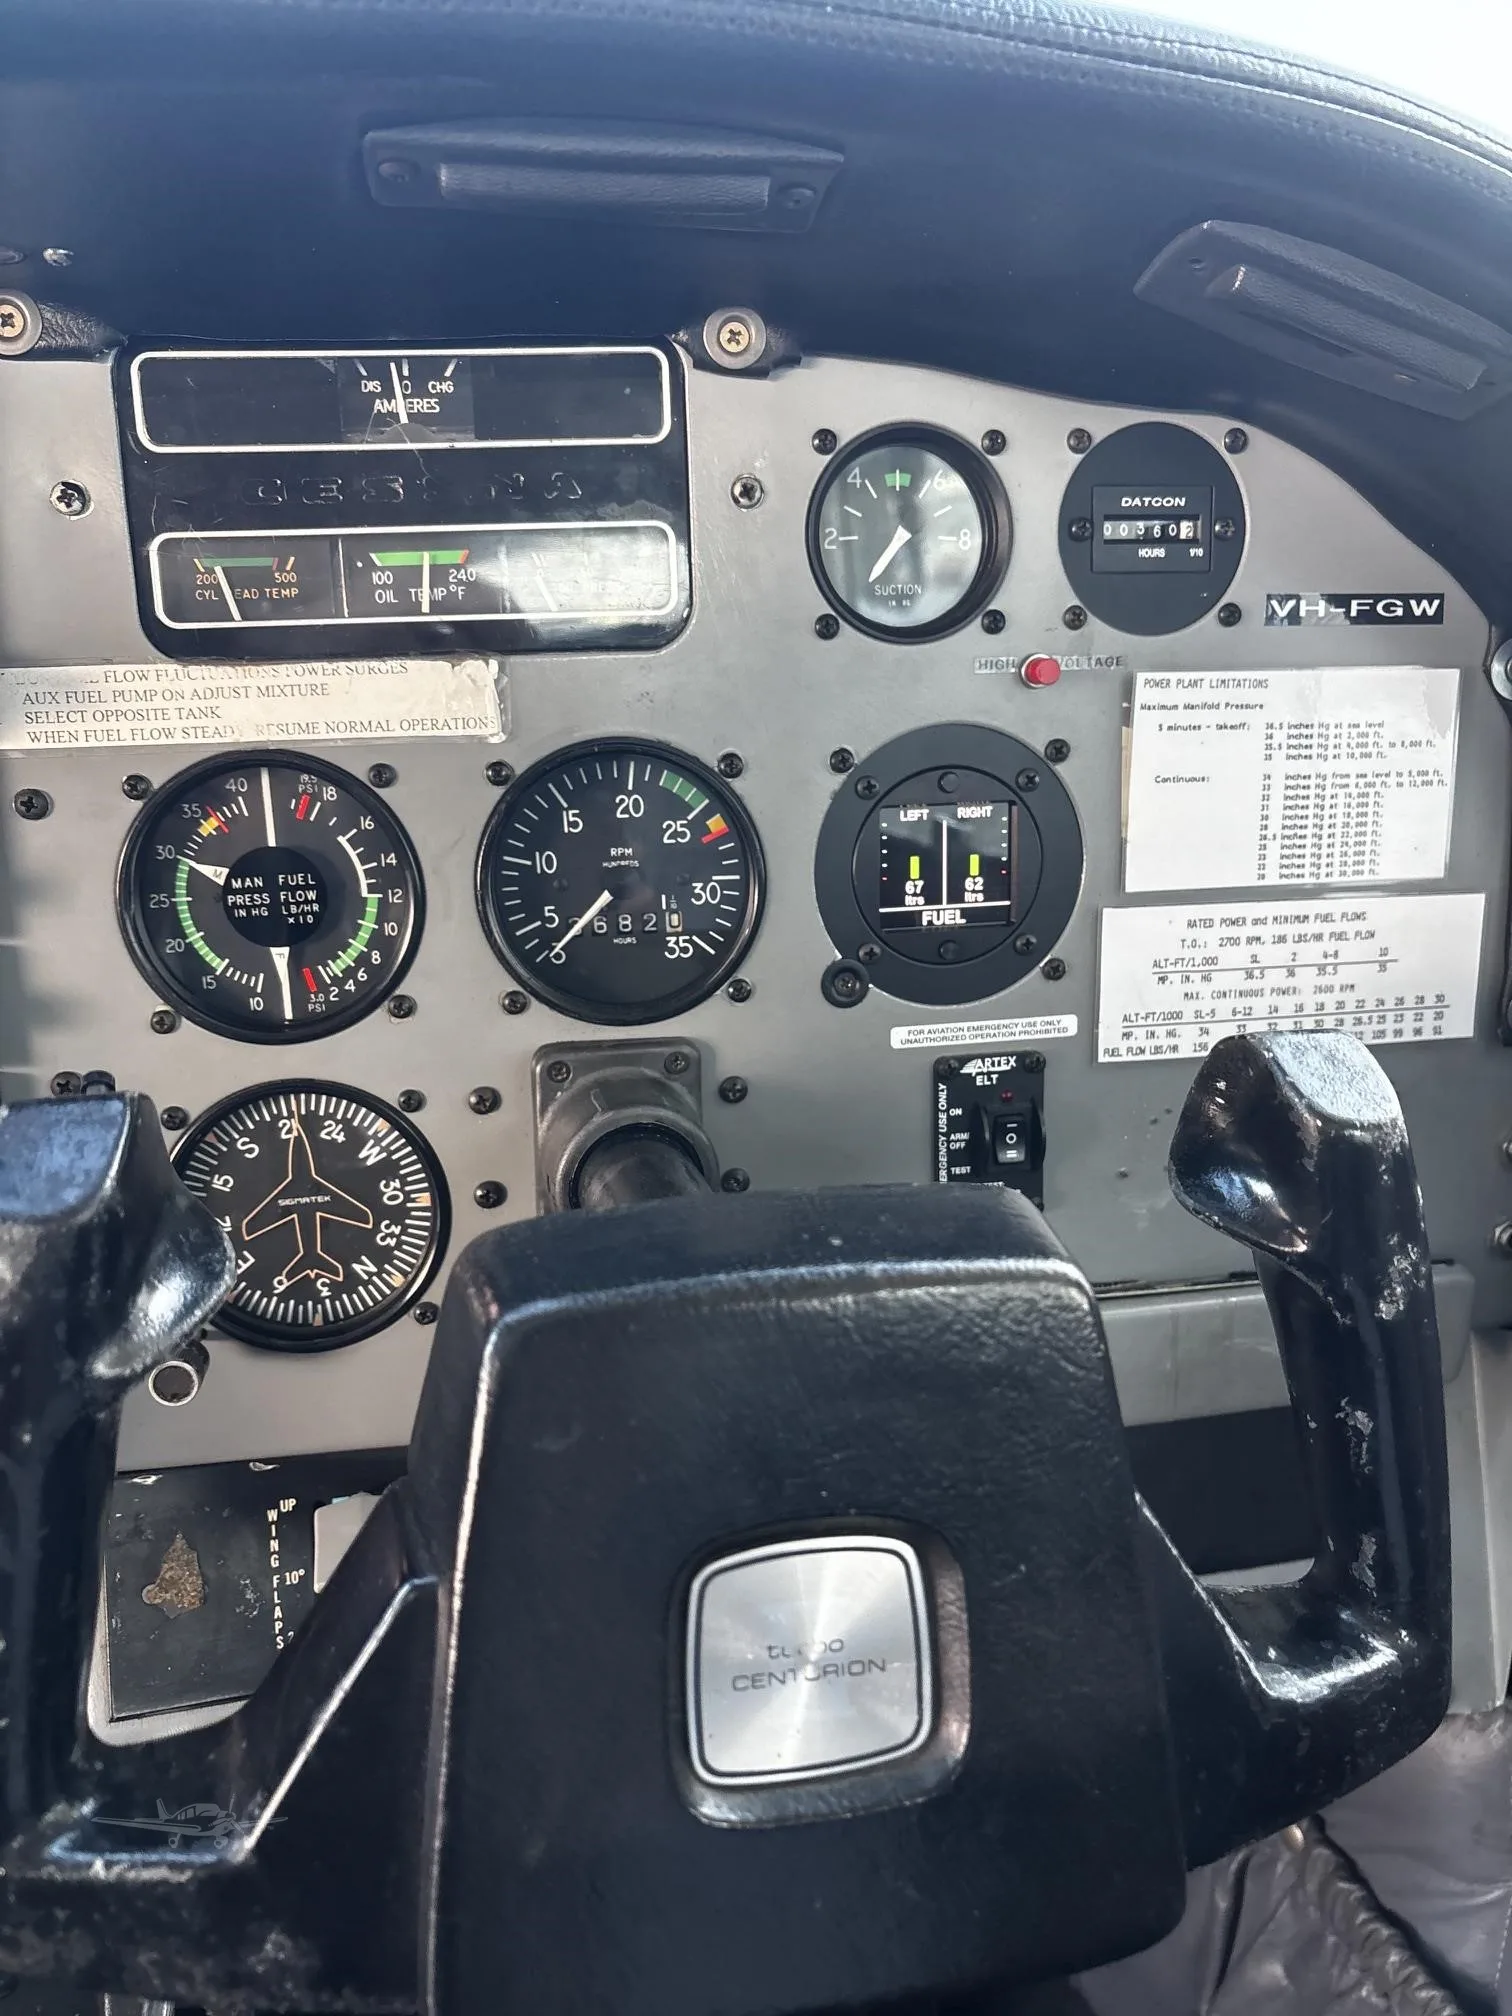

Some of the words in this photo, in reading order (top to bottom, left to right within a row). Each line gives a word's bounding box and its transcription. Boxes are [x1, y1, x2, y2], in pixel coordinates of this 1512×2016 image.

[361, 380, 381, 392] DIS
[428, 380, 454, 393] CHG
[374, 398, 440, 413] AMERES
[846, 466, 862, 489] 4
[933, 469, 947, 491] 6
[1121, 497, 1186, 507] DATCON
[824, 527, 838, 549] 2
[958, 528, 972, 550] 8
[1138, 548, 1166, 558] HOURS
[195, 574, 219, 585] 200
[274, 572, 297, 583] 500
[372, 571, 393, 584] 100
[449, 568, 476, 583] 240
[195, 589, 219, 600] CYL
[228, 588, 259, 600] EAD
[264, 588, 299, 599] TEMP
[375, 590, 399, 604] OIL
[874, 583, 922, 597] SUCTION
[1269, 598, 1441, 618] VH-FGW
[978, 657, 1016, 671] HIGH
[104, 670, 150, 683] FLOW
[1143, 679, 1171, 689] POWER
[1176, 678, 1205, 689] PLANT
[1209, 678, 1269, 689] LIMITATIONS
[22, 691, 60, 705] AUX
[65, 690, 107, 704] FUEL
[112, 688, 158, 703] PUMP
[162, 688, 185, 702] ON
[190, 685, 251, 701] ADJUST
[256, 683, 330, 698] MIXTURE
[1140, 703, 1179, 711] Maximum
[1183, 702, 1220, 711] Manifold
[1224, 702, 1264, 711] Pressure
[24, 709, 88, 724] SELECT
[92, 708, 170, 723] OPPOSITE
[174, 706, 222, 721] TANK
[27, 730, 81, 744] WHEN
[84, 729, 127, 743] FUEL
[130, 727, 177, 742] FLOW
[324, 719, 395, 735] NORMAL
[399, 715, 497, 732] OPERATIONS
[1167, 723, 1202, 731] minutes
[225, 778, 248, 793] 40
[323, 786, 337, 801] 18
[181, 803, 201, 818] 35
[615, 795, 644, 818] 20
[957, 806, 993, 819] RIGHT
[562, 809, 584, 833] 15
[900, 808, 929, 821] LEFT
[360, 815, 375, 830] 16
[662, 820, 691, 844] 25
[155, 845, 176, 860] 30
[610, 847, 633, 857] RPM
[381, 853, 398, 867] 14
[535, 851, 557, 874] 10
[231, 876, 263, 889] MAN
[278, 873, 316, 886] FUEL
[965, 877, 984, 891] 62
[691, 882, 721, 905] 30
[905, 880, 924, 894] 67
[150, 894, 170, 909] 25
[227, 893, 271, 906] PRESS
[280, 890, 317, 903] FLOW
[388, 889, 403, 903] 12
[234, 908, 247, 918] IN
[251, 906, 269, 917] HG
[281, 903, 320, 915] LB/HR
[544, 906, 560, 928] 5
[921, 909, 966, 926] FUEL
[1187, 918, 1214, 929] RATED
[1220, 917, 1246, 928] POWER
[1251, 916, 1268, 926] and
[1272, 914, 1310, 926] MINIMUM
[1314, 913, 1336, 924] FUEL
[1340, 911, 1366, 922] FLOWS
[384, 922, 398, 937] 10
[1218, 937, 1240, 947] 2700
[1271, 934, 1287, 945] 186
[1292, 932, 1324, 944] LBS/HR
[1329, 931, 1350, 942] FUEL
[1354, 930, 1375, 940] FLOW
[165, 939, 185, 953] 20
[664, 935, 694, 959] 35
[371, 950, 382, 964] 8
[357, 968, 368, 982] 6
[202, 976, 217, 990] 15
[344, 979, 356, 992] 4
[329, 987, 340, 1001] 2
[1211, 987, 1264, 1000] CONTINUOUS
[1313, 984, 1334, 995] 2600
[1339, 983, 1355, 994] RPM
[249, 997, 264, 1011] 10
[308, 1003, 326, 1013] PSI
[1122, 1010, 1183, 1024] ALT-FT/1000
[908, 1029, 925, 1038] FOR
[927, 1026, 965, 1036] AVIATION
[966, 1022, 1020, 1033] EMERGENCY
[1021, 1020, 1038, 1029] USE
[1039, 1019, 1062, 1028] ONLY
[900, 1034, 967, 1046] UNAUTHORIZED
[968, 1030, 1016, 1042] OPERATION
[1018, 1026, 1068, 1038] PROHIBITED
[1103, 1046, 1122, 1058] FUEL
[1126, 1045, 1146, 1056] FLOW
[1149, 1044, 1179, 1056] LBS/HR
[974, 1055, 1017, 1075] ARTEX
[975, 1074, 999, 1086] ELT
[938, 1082, 948, 1111] ONLY
[949, 1107, 963, 1117] ON
[938, 1112, 948, 1133] USE
[320, 1120, 346, 1143] 24
[236, 1138, 259, 1159] S
[358, 1139, 387, 1166] W
[949, 1142, 967, 1150] OFF
[938, 1135, 948, 1184] ERGENCY
[950, 1166, 972, 1175] TEST
[212, 1173, 234, 1192] 15
[380, 1178, 404, 1206] 30
[277, 1195, 332, 1207] SIGMATEK
[376, 1219, 401, 1247] 33
[351, 1255, 378, 1280] N
[317, 1278, 332, 1297] 3
[279, 1499, 296, 1512] UP
